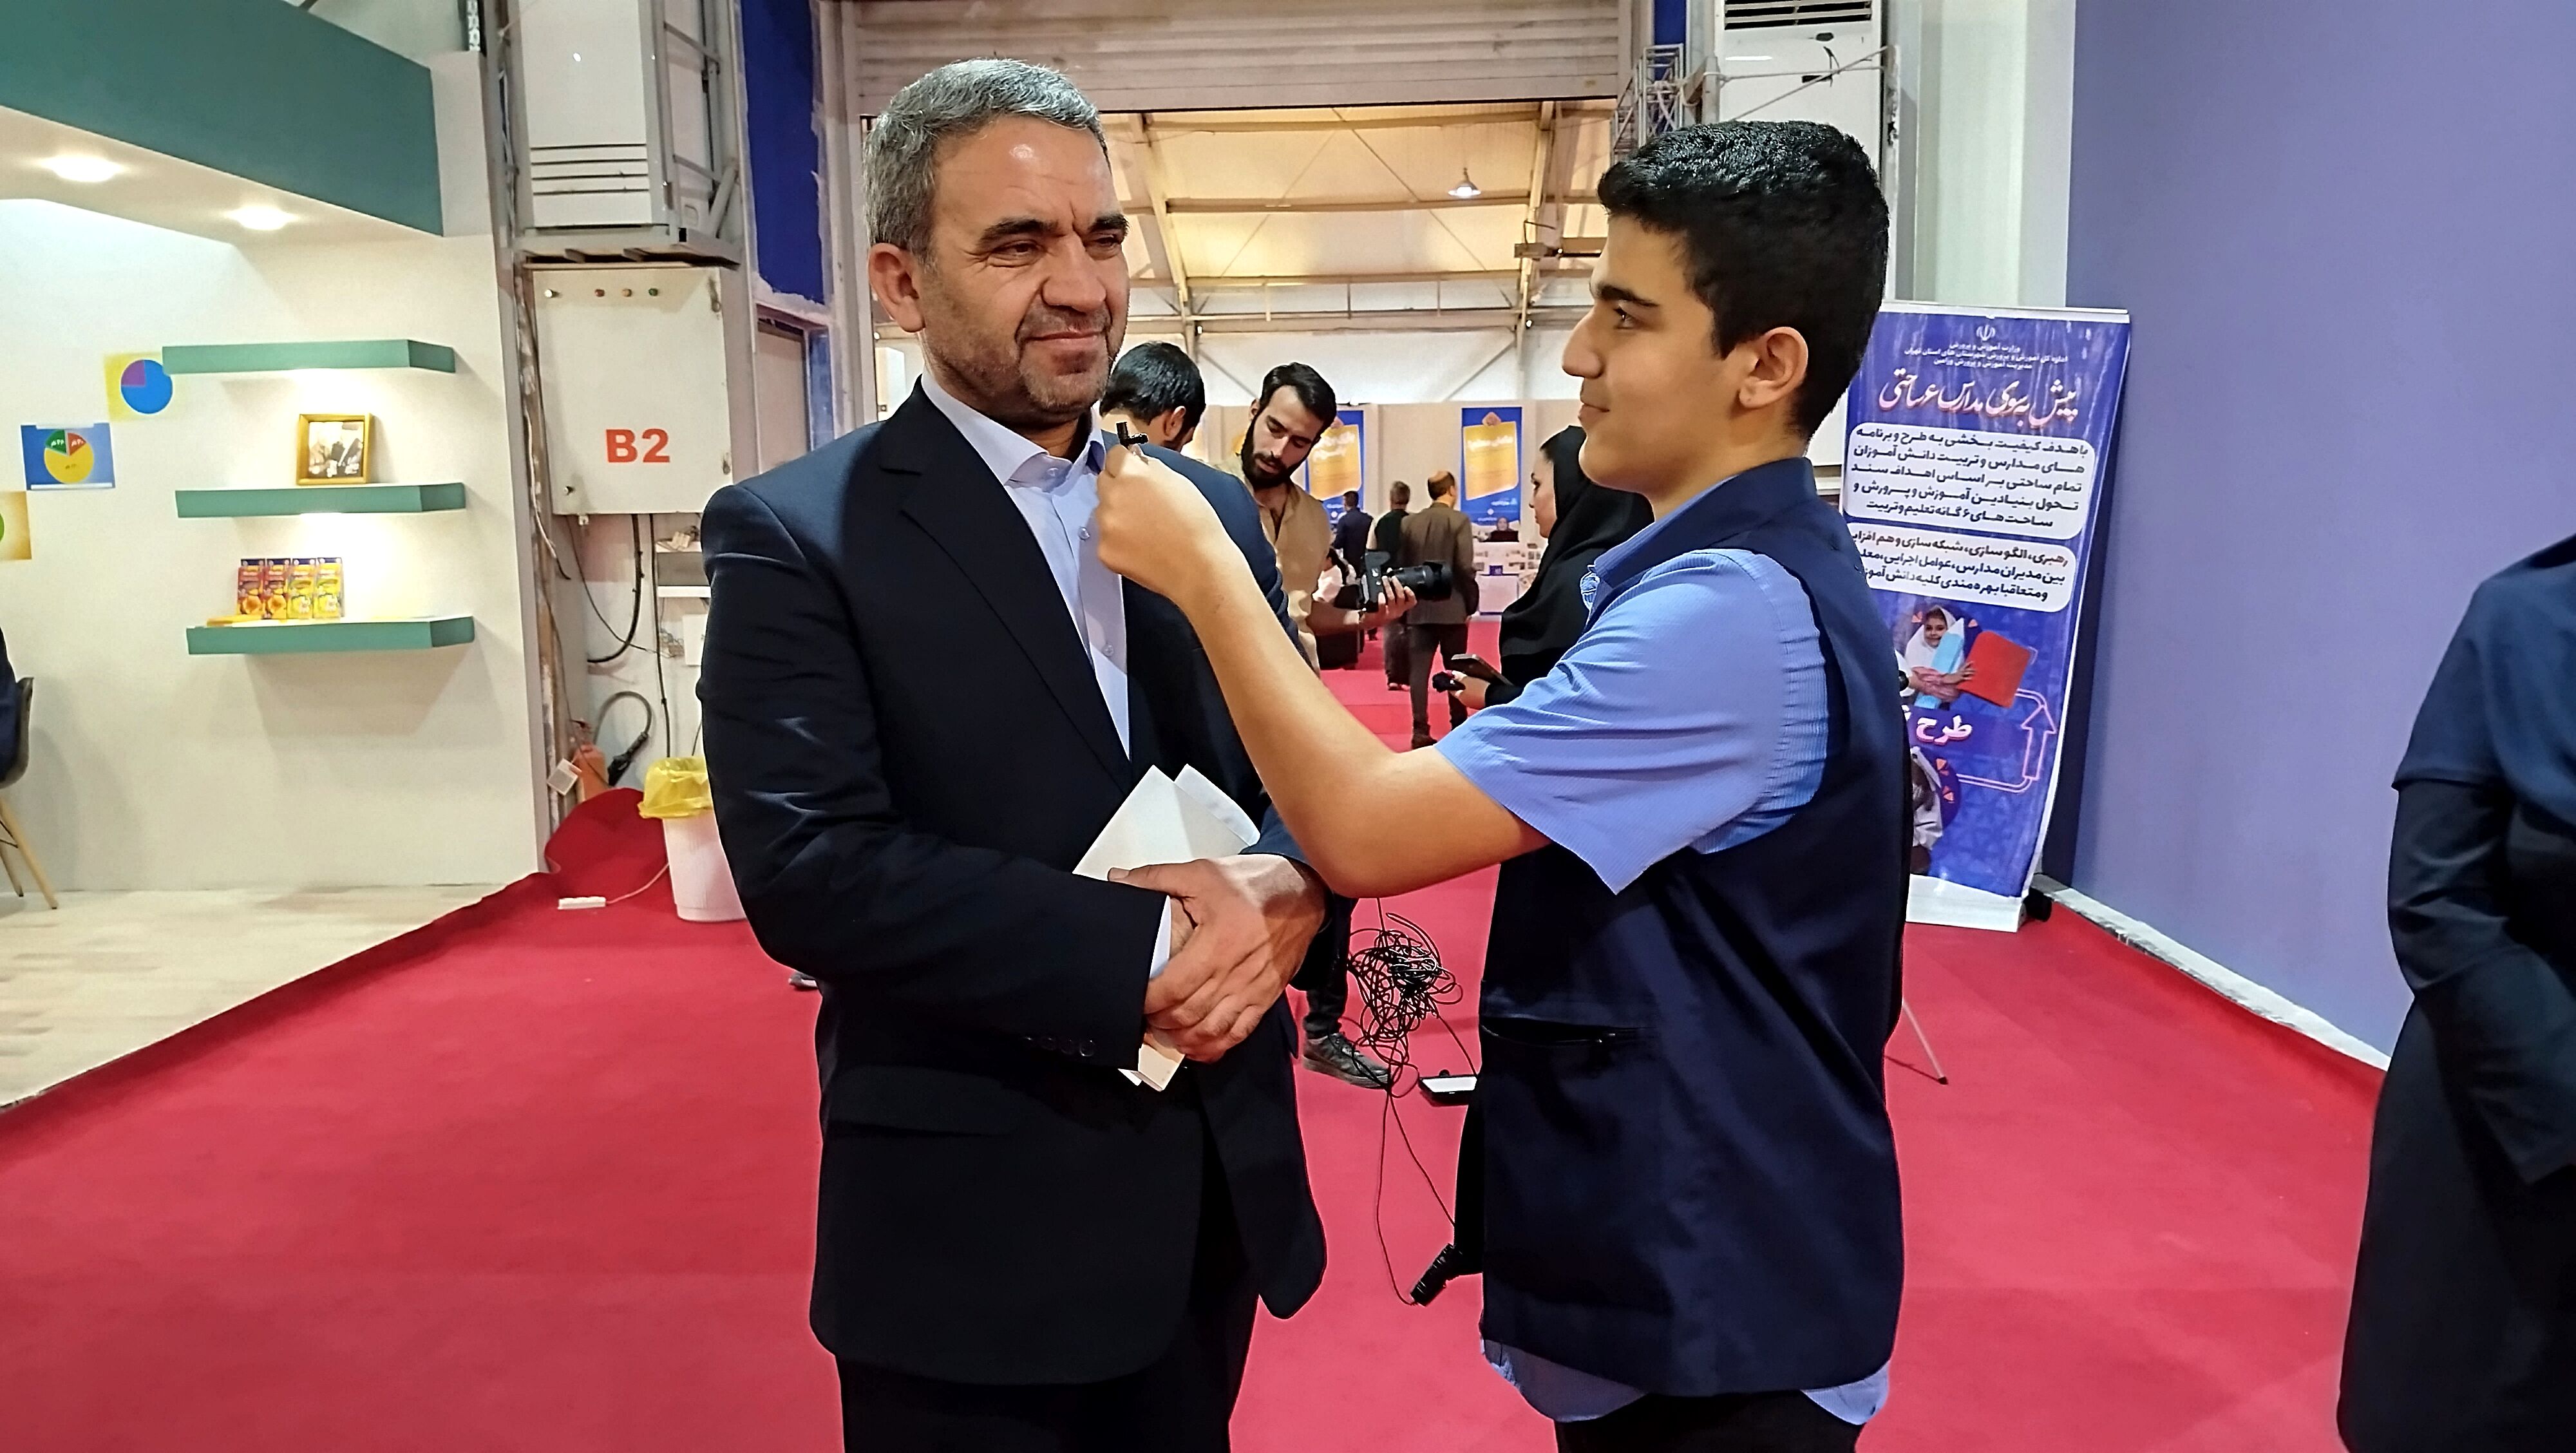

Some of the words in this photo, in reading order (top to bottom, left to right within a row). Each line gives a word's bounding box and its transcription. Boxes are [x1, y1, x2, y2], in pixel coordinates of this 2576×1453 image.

[1937, 380, 1984, 413] مدارس
[2028, 379, 2079, 428] پیش
[1855, 428, 1893, 442] برنامه
[1893, 432, 1899, 442] و
[1900, 431, 1927, 444] طرح
[1928, 433, 1944, 446] به
[1944, 433, 1993, 451] بخشی
[606, 428, 670, 462] B2
[1853, 444, 1899, 459] آموزان
[1994, 439, 2041, 454] کیفیت
[2042, 441, 2079, 455] هدف
[1898, 447, 1936, 461] دانش
[1937, 453, 1980, 467] تربیت
[1851, 463, 1889, 474] سند
[1980, 458, 1987, 468] و
[1988, 457, 2040, 471] مدارس
[2041, 461, 2085, 474] های
[1889, 464, 1936, 478] اهداف
[1936, 471, 1985, 483] اساس
[1853, 482, 1860, 493] و
[1861, 480, 1911, 499] پرورش
[1984, 479, 2005, 489] بر
[2005, 478, 2053, 490] ساحتی
[2052, 481, 2082, 495] تمام
[1911, 488, 1918, 498] و
[1918, 485, 1973, 501] آموزش
[1866, 501, 1899, 514] تربیت
[1971, 493, 2034, 509] بنیادین
[2035, 498, 2079, 512] تحول
[1903, 504, 1935, 517] تعلیم
[1935, 506, 1962, 517] گانه
[1969, 511, 2005, 522] های
[2004, 515, 2054, 527] ساحت
[1852, 530, 1877, 544] افزای
[1875, 535, 1895, 546] هم
[1901, 537, 1931, 549] سازی
[1931, 540, 1964, 553] شبکه
[1860, 548, 1880, 560] معل
[1918, 556, 1952, 571] عوامل
[1865, 565, 1886, 579] آموز
[1885, 569, 1917, 582] دانش
[2000, 565, 2042, 581] مدیران
[2041, 572, 2066, 586] بین
[1916, 714, 1973, 746] طرح
